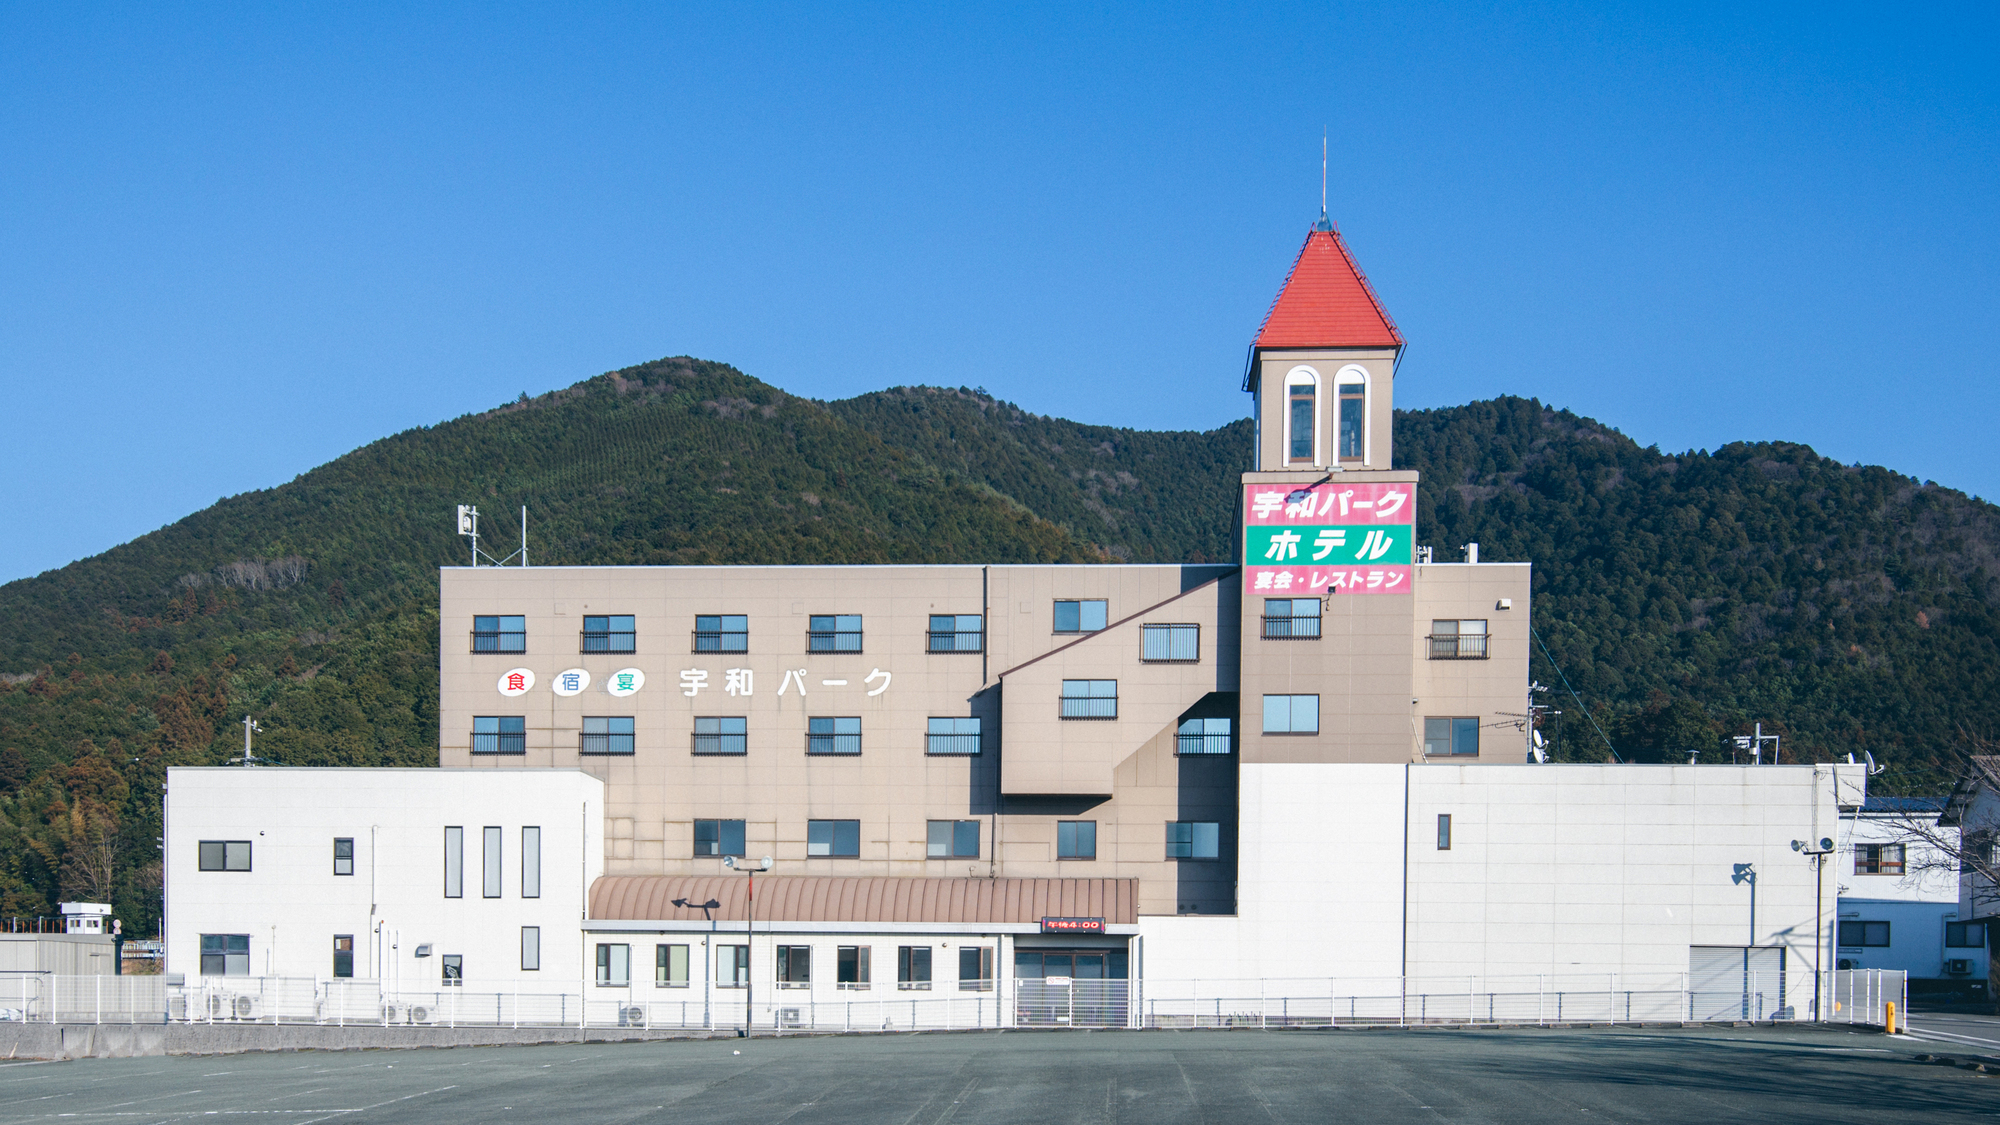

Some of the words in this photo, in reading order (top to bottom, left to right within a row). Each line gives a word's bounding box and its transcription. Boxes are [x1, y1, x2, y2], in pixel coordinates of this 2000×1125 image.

[1251, 489, 1408, 519] 宇和パーク
[1264, 529, 1394, 561] ホテル
[1254, 571, 1405, 590] 宴会・レストラン
[507, 672, 525, 691] 食
[562, 672, 580, 691] 宿
[616, 672, 635, 691] 宴
[679, 667, 893, 697] 宇和パーク
